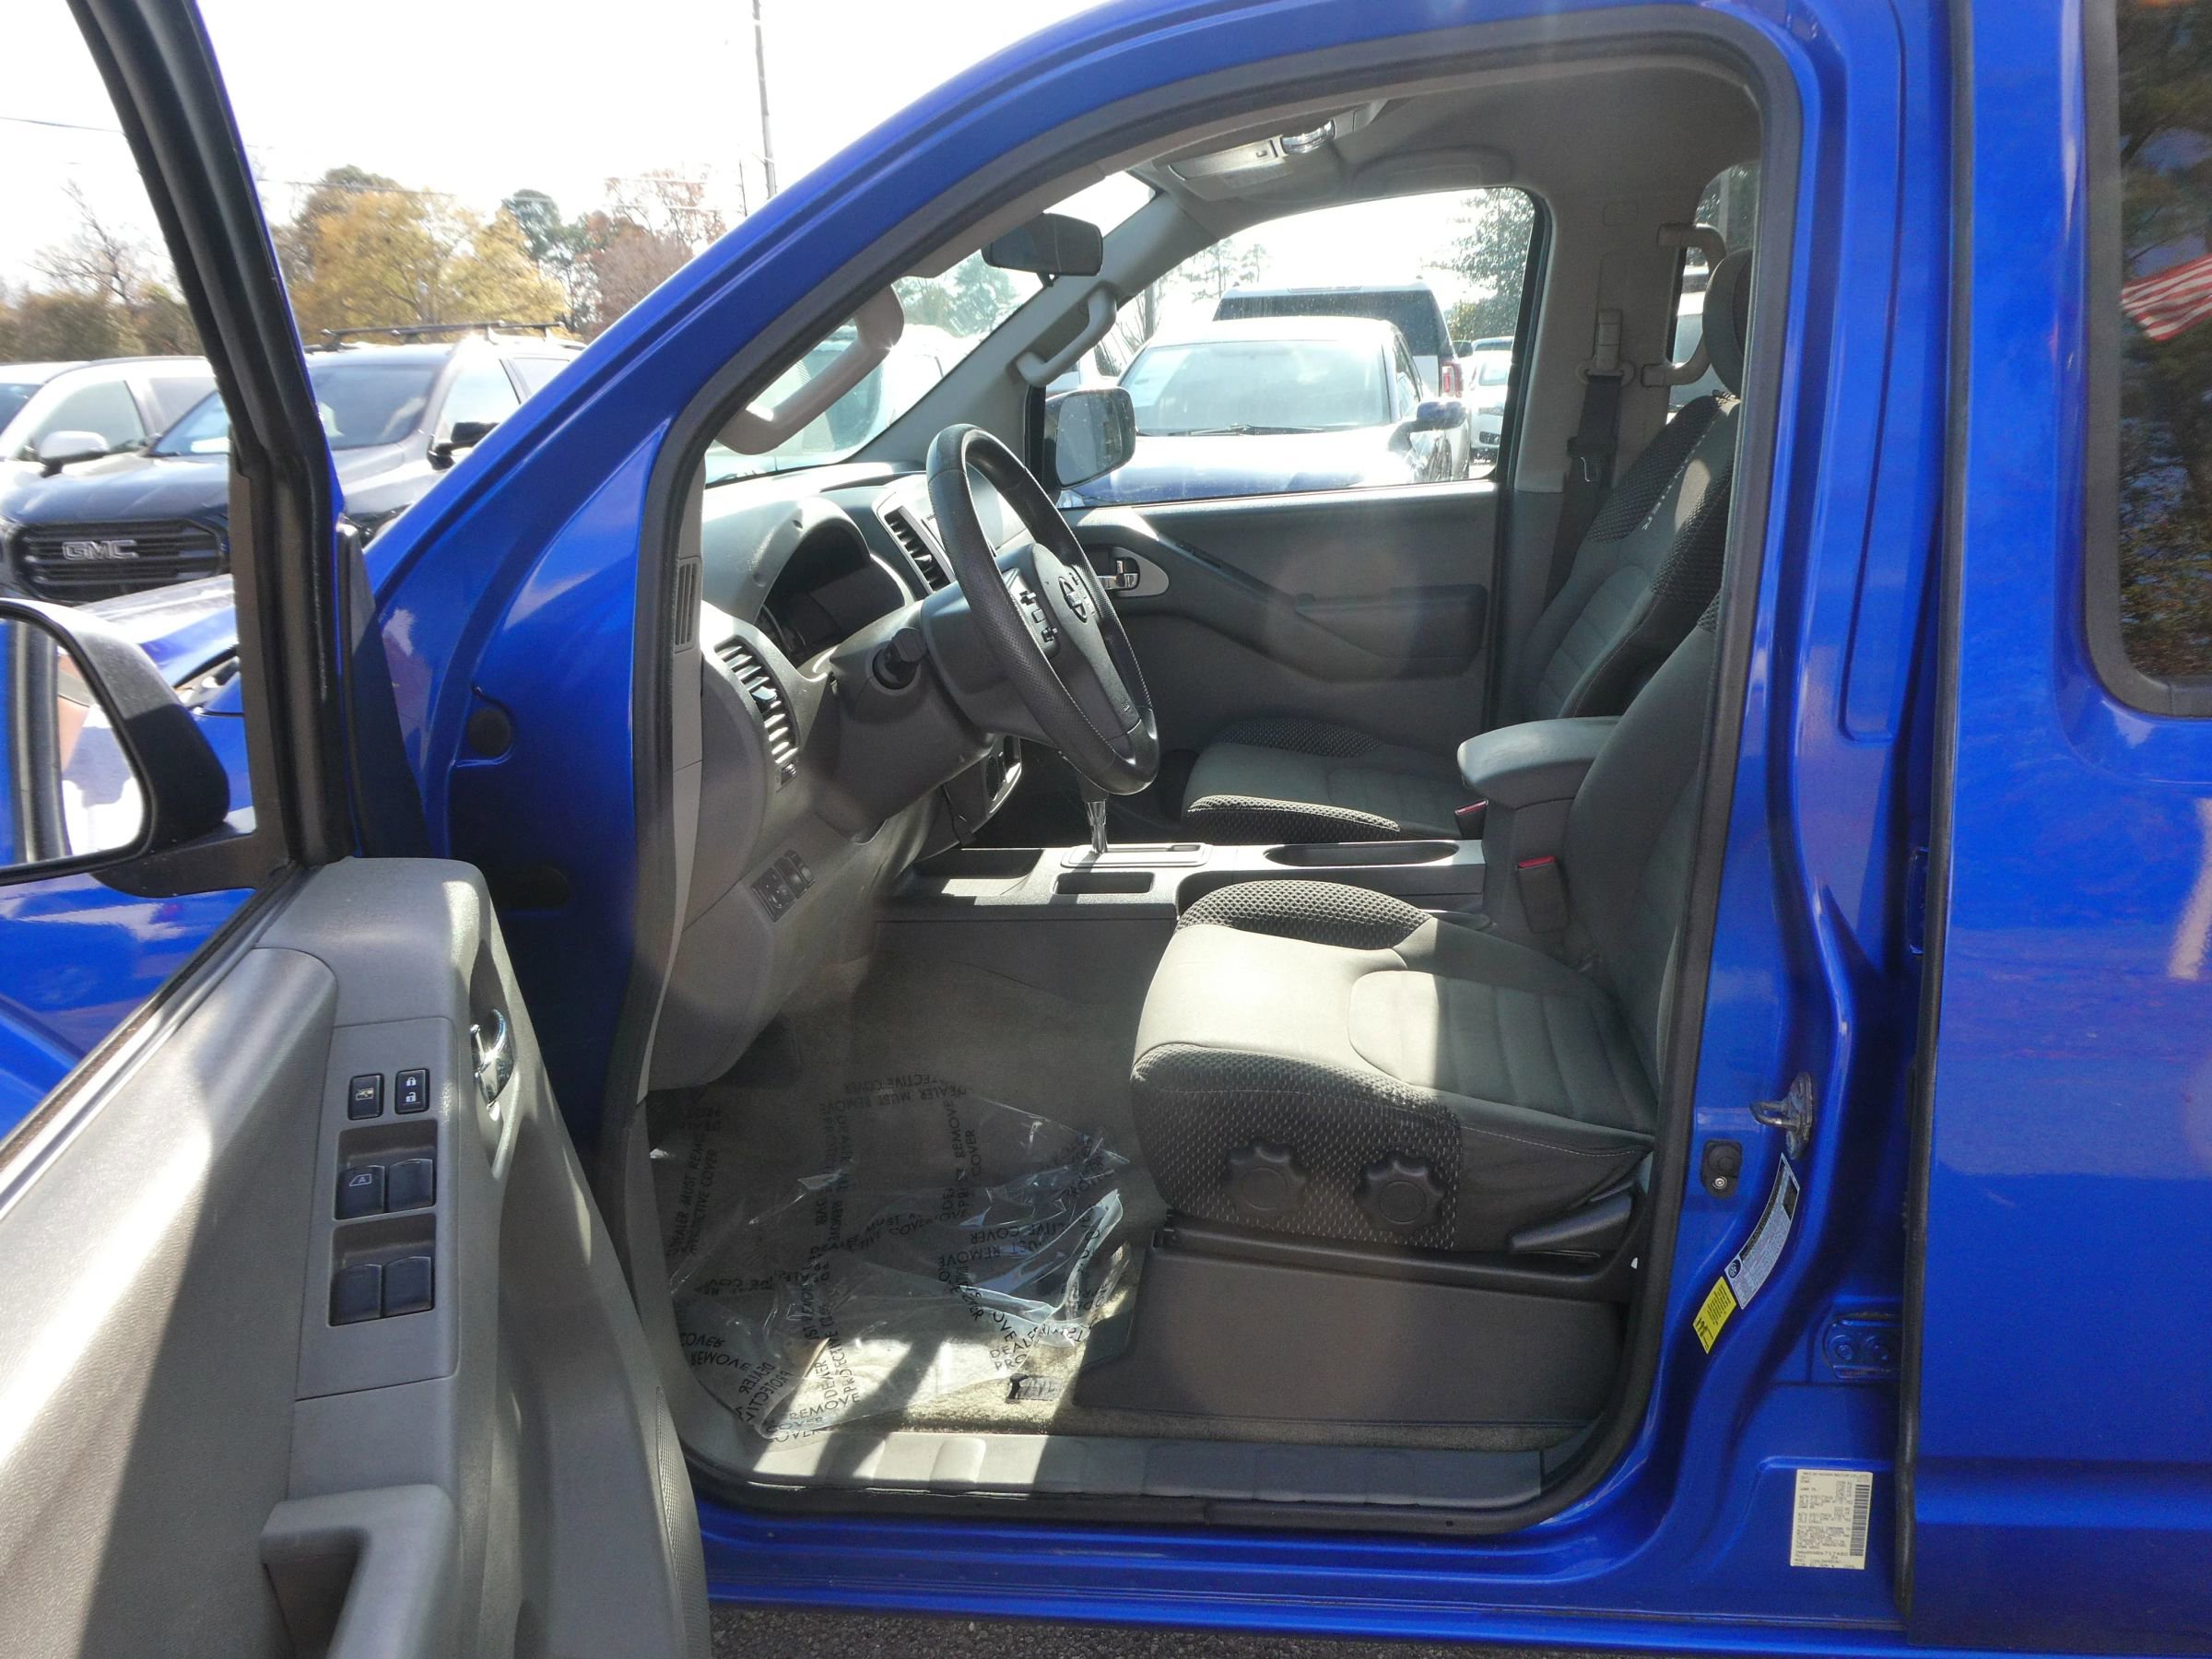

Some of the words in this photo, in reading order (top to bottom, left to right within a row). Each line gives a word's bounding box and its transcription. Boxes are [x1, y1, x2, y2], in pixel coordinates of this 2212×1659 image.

[62, 539, 139, 560] GMC
[942, 1099, 966, 1158] REMOVE
[700, 1147, 719, 1188] COVER
[965, 1129, 982, 1177] COVER
[679, 1172, 697, 1206] MUST
[969, 1226, 1020, 1245] COVER
[937, 1244, 1001, 1268] REMOVE
[789, 1392, 861, 1420] REMOVE
